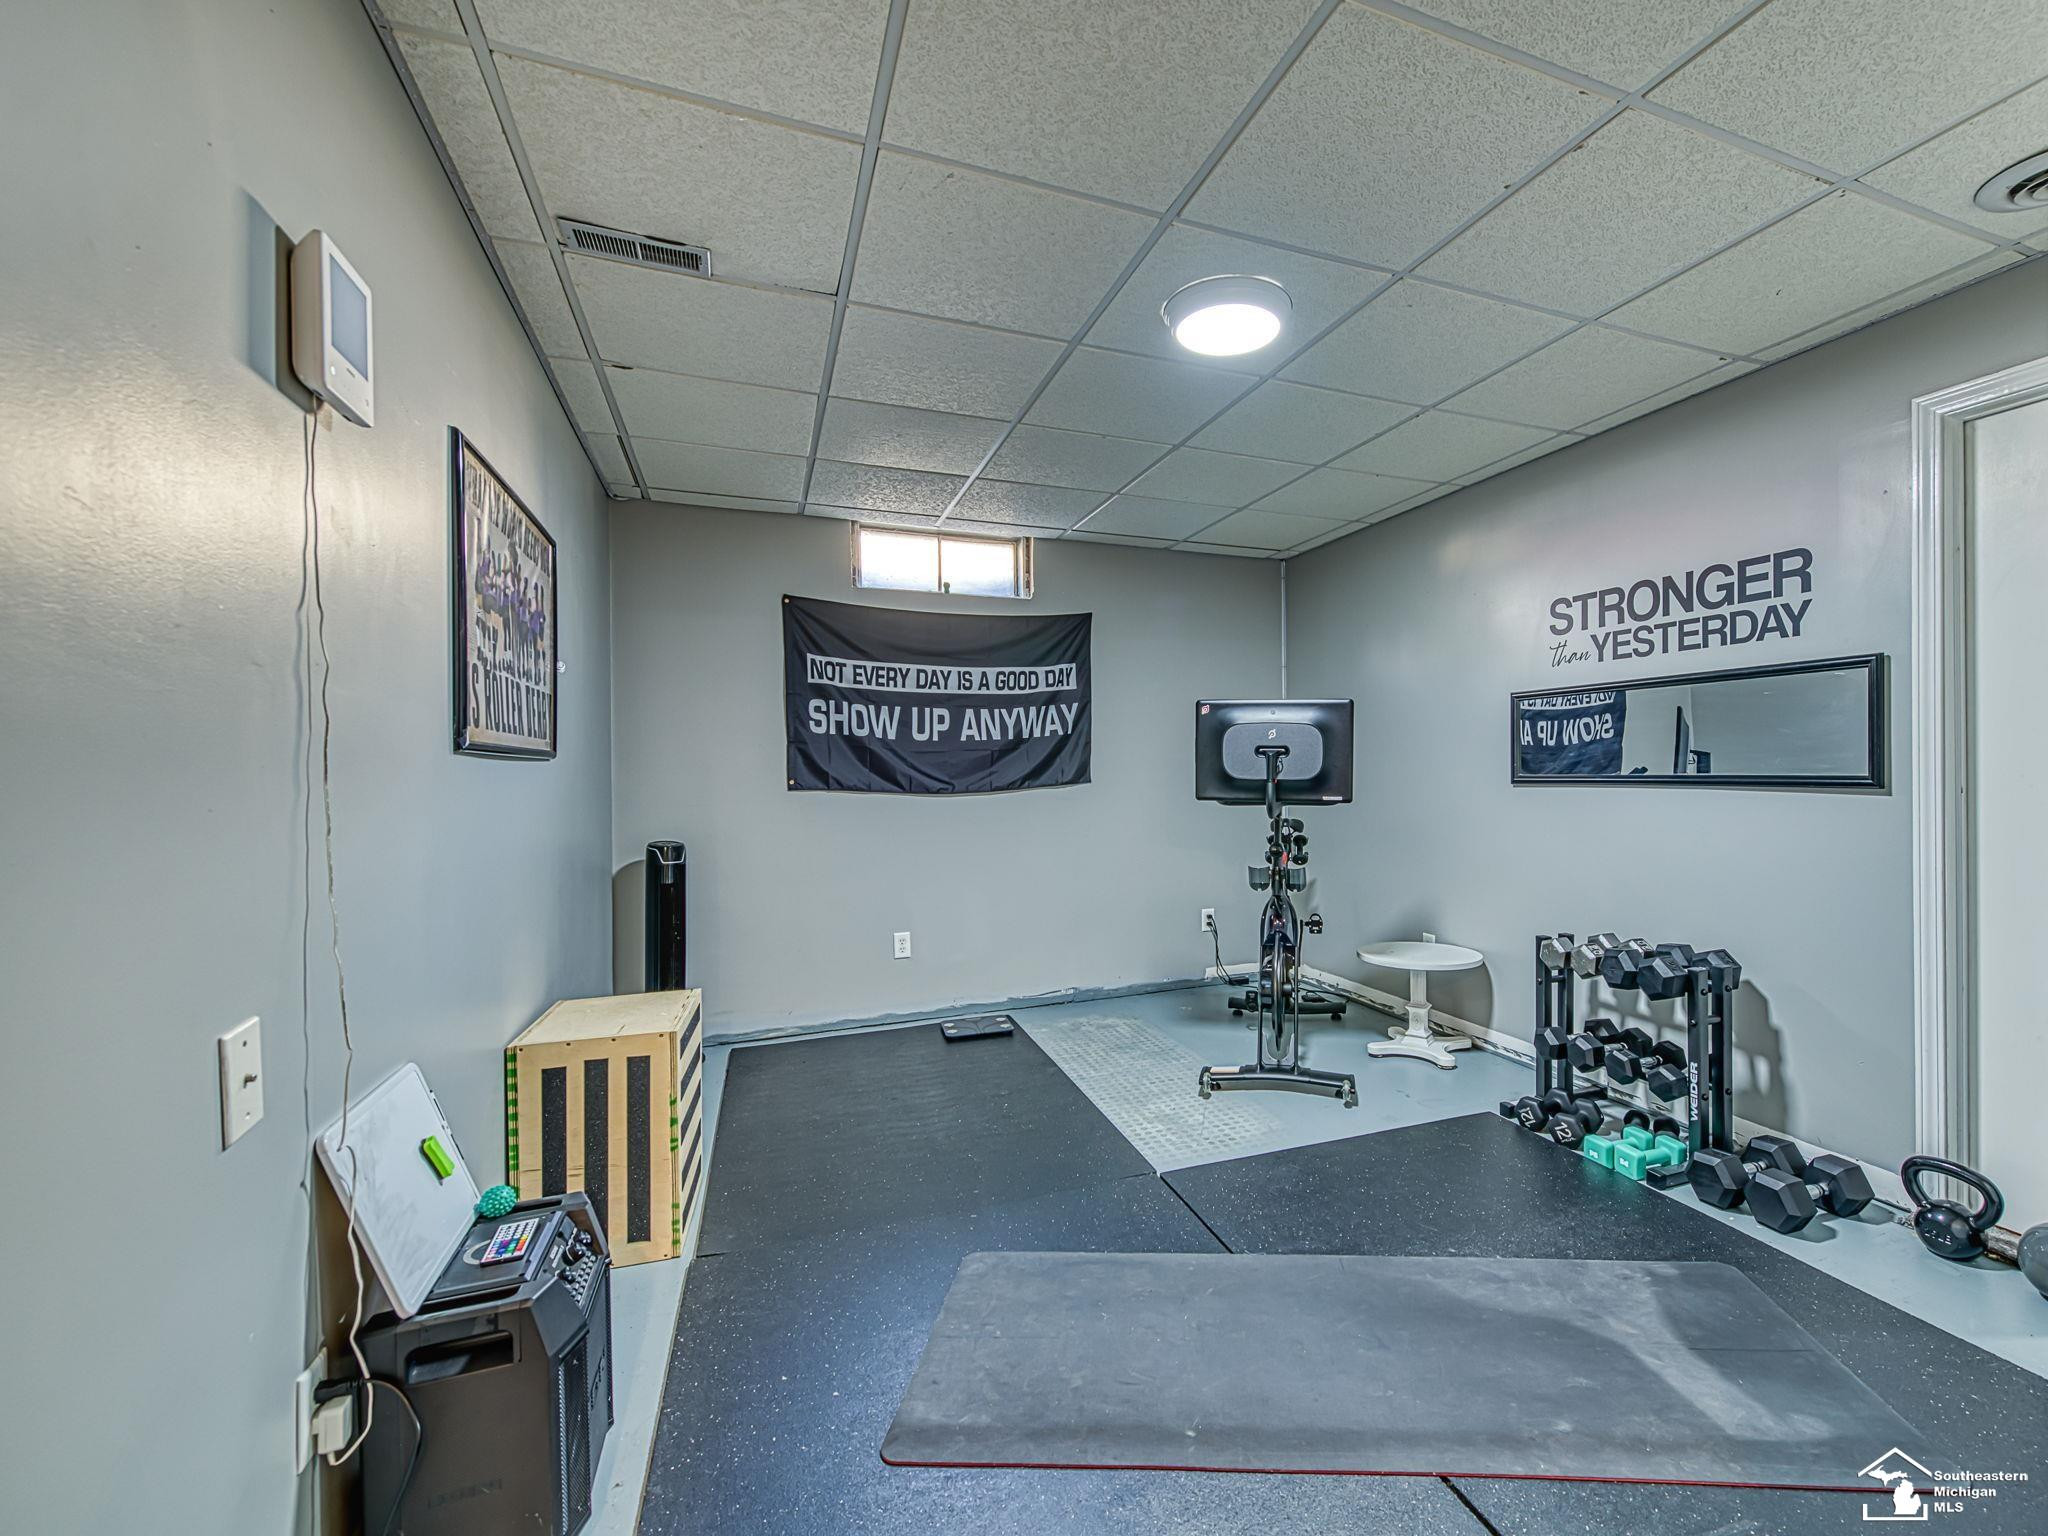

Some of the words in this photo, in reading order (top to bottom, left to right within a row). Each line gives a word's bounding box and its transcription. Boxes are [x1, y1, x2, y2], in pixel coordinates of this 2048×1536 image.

[1549, 547, 1814, 636] STRONGER
[1549, 640, 1592, 668] than
[1590, 598, 1813, 663] YESTERDAY
[809, 657, 847, 684] NOT
[852, 664, 911, 689] EVERY
[915, 668, 952, 691] DAY
[957, 670, 974, 691] IS
[978, 670, 991, 691] A
[995, 670, 1040, 692] GOOD
[1045, 667, 1074, 689] DAY
[484, 669, 525, 736] ROLLER
[808, 698, 901, 741] SHOW
[911, 706, 950, 742] UP
[960, 702, 1079, 742] ANYWAY
[1690, 1061, 1699, 1121] WEIDER
[1520, 1110, 1536, 1128] 12
[1554, 1121, 1572, 1140] 12
